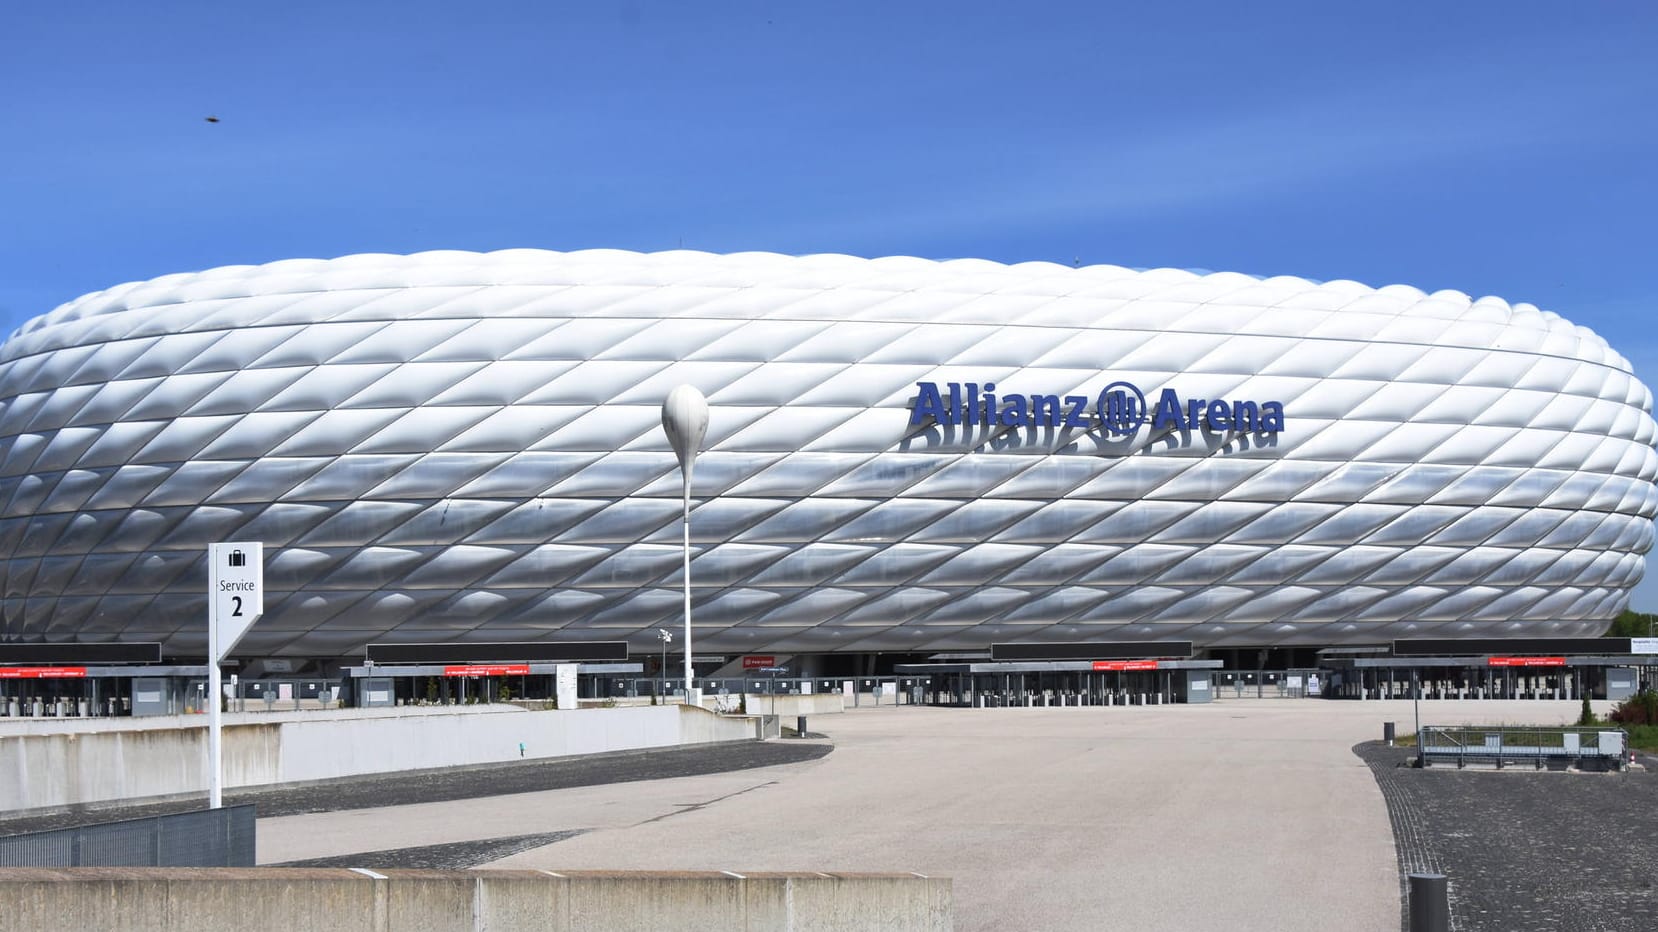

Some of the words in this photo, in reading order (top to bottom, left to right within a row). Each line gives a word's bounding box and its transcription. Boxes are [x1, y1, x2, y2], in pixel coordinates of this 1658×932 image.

[911, 381, 1090, 428] Allianz
[1152, 388, 1285, 432] Arena
[220, 579, 255, 592] Service
[231, 596, 243, 617] 2
